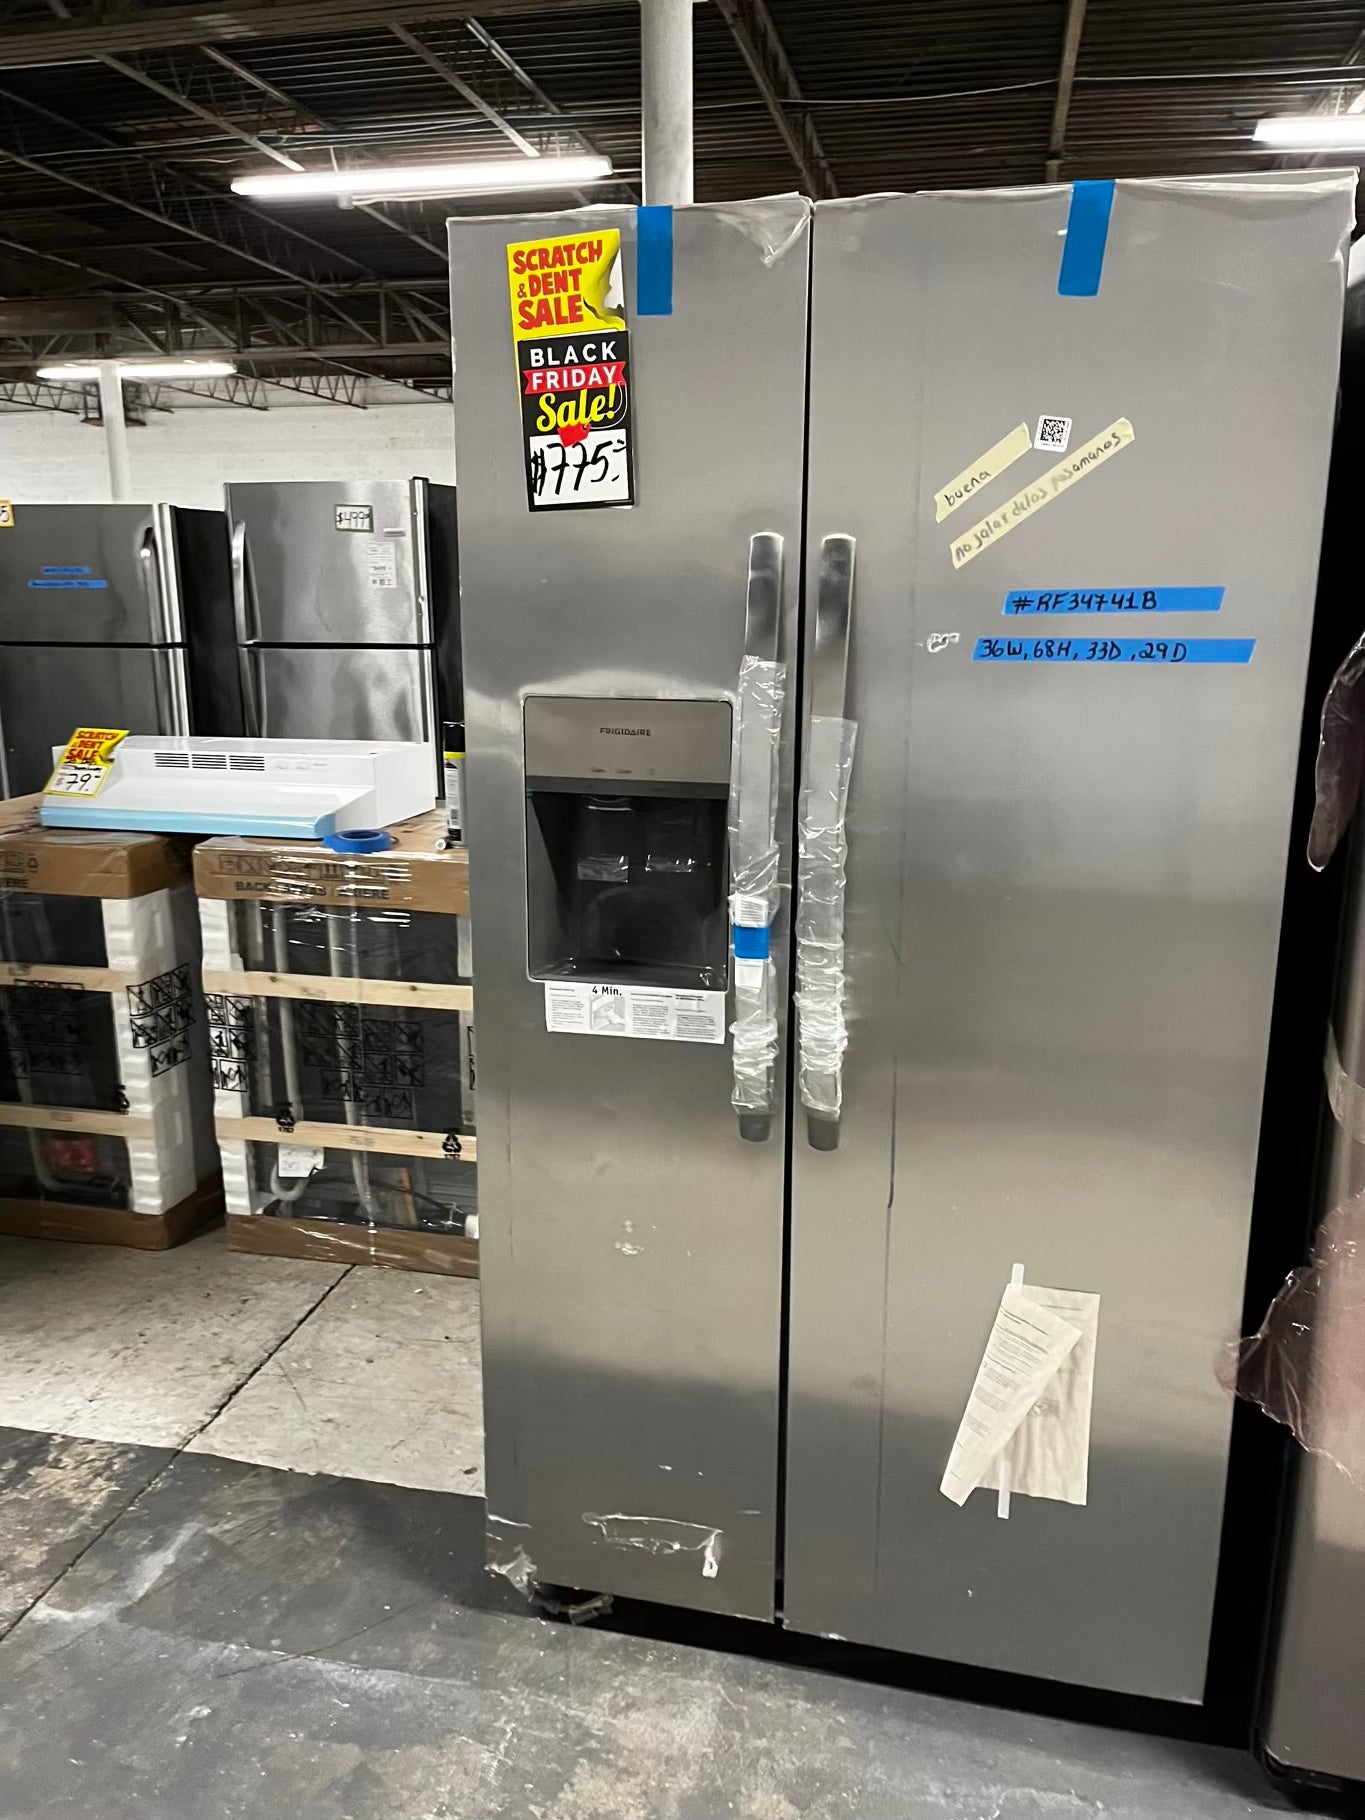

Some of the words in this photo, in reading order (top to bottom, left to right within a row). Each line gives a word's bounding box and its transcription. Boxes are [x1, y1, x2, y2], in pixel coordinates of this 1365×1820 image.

[512, 239, 603, 275] SCRATCH
[516, 282, 528, 298] &
[528, 268, 583, 298] DENT
[518, 296, 584, 330] SALE
[530, 341, 617, 367] BLACK
[532, 366, 616, 390] FRIDAY
[536, 384, 617, 432] Sale!
[944, 471, 991, 507] buena
[955, 543, 972, 561] no
[600, 728, 651, 737] FRIGIDAIRE
[66, 748, 100, 760] SALE
[592, 986, 598, 995] 4
[602, 987, 622, 996] Min.
